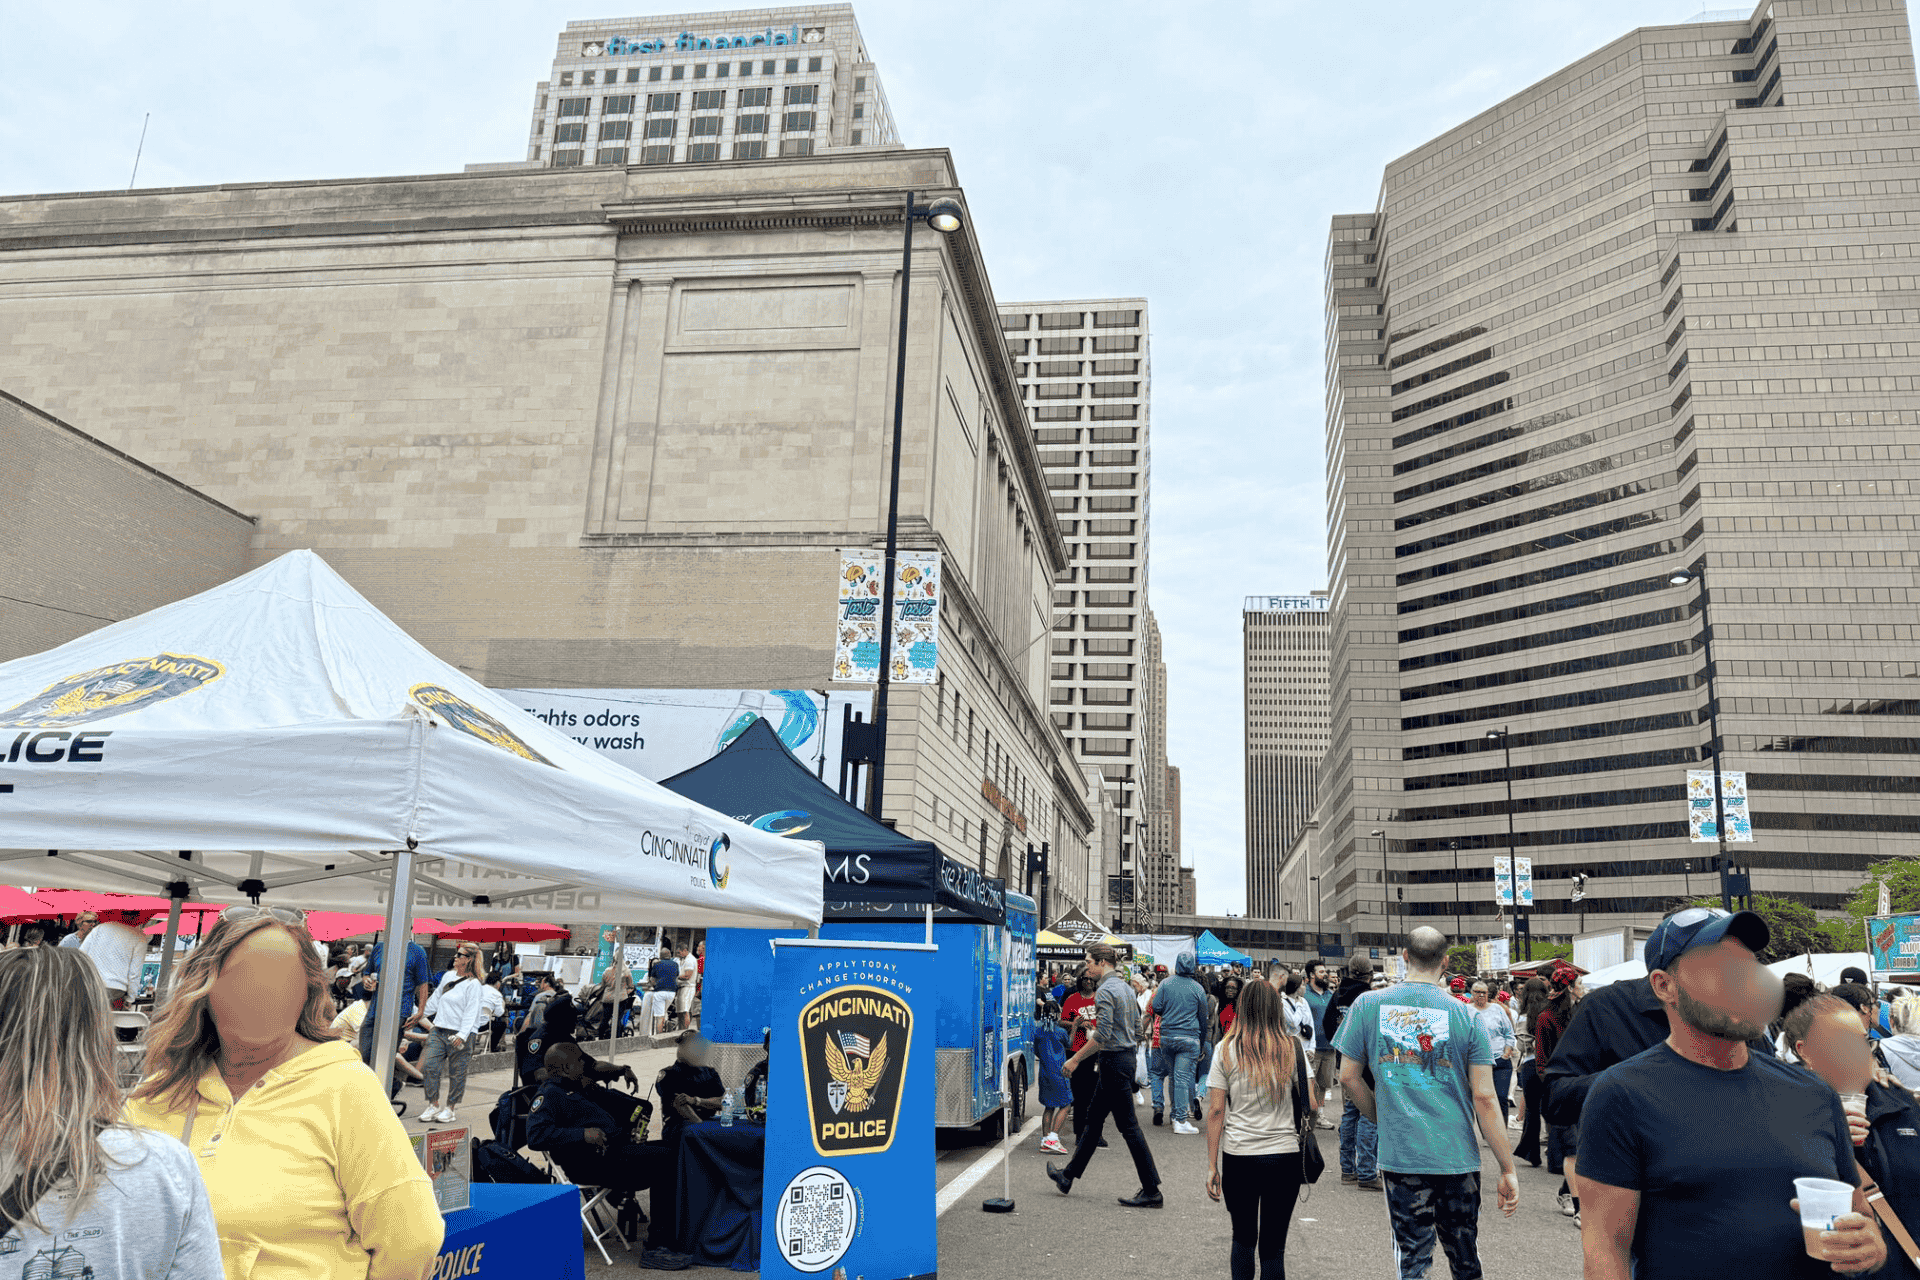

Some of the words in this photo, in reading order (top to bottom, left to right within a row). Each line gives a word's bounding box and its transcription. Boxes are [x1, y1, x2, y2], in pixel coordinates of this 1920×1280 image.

[607, 34, 666, 55] first
[675, 22, 798, 51] financial
[1269, 598, 1310, 608] FIFTH
[583, 708, 640, 726] odors
[0, 731, 114, 762] ICE
[594, 731, 645, 749] wash
[641, 830, 707, 870] CINCINNATI
[824, 853, 871, 883] MS
[690, 876, 706, 889] POLICE
[819, 960, 856, 972] APPLY
[862, 960, 898, 974] TODAY,
[800, 973, 848, 995] CHANGE
[853, 972, 912, 994] TOMORROW
[807, 997, 907, 1029] CINCINNATI
[822, 1119, 887, 1140] POLICE
[430, 1242, 485, 1280] POLICE
